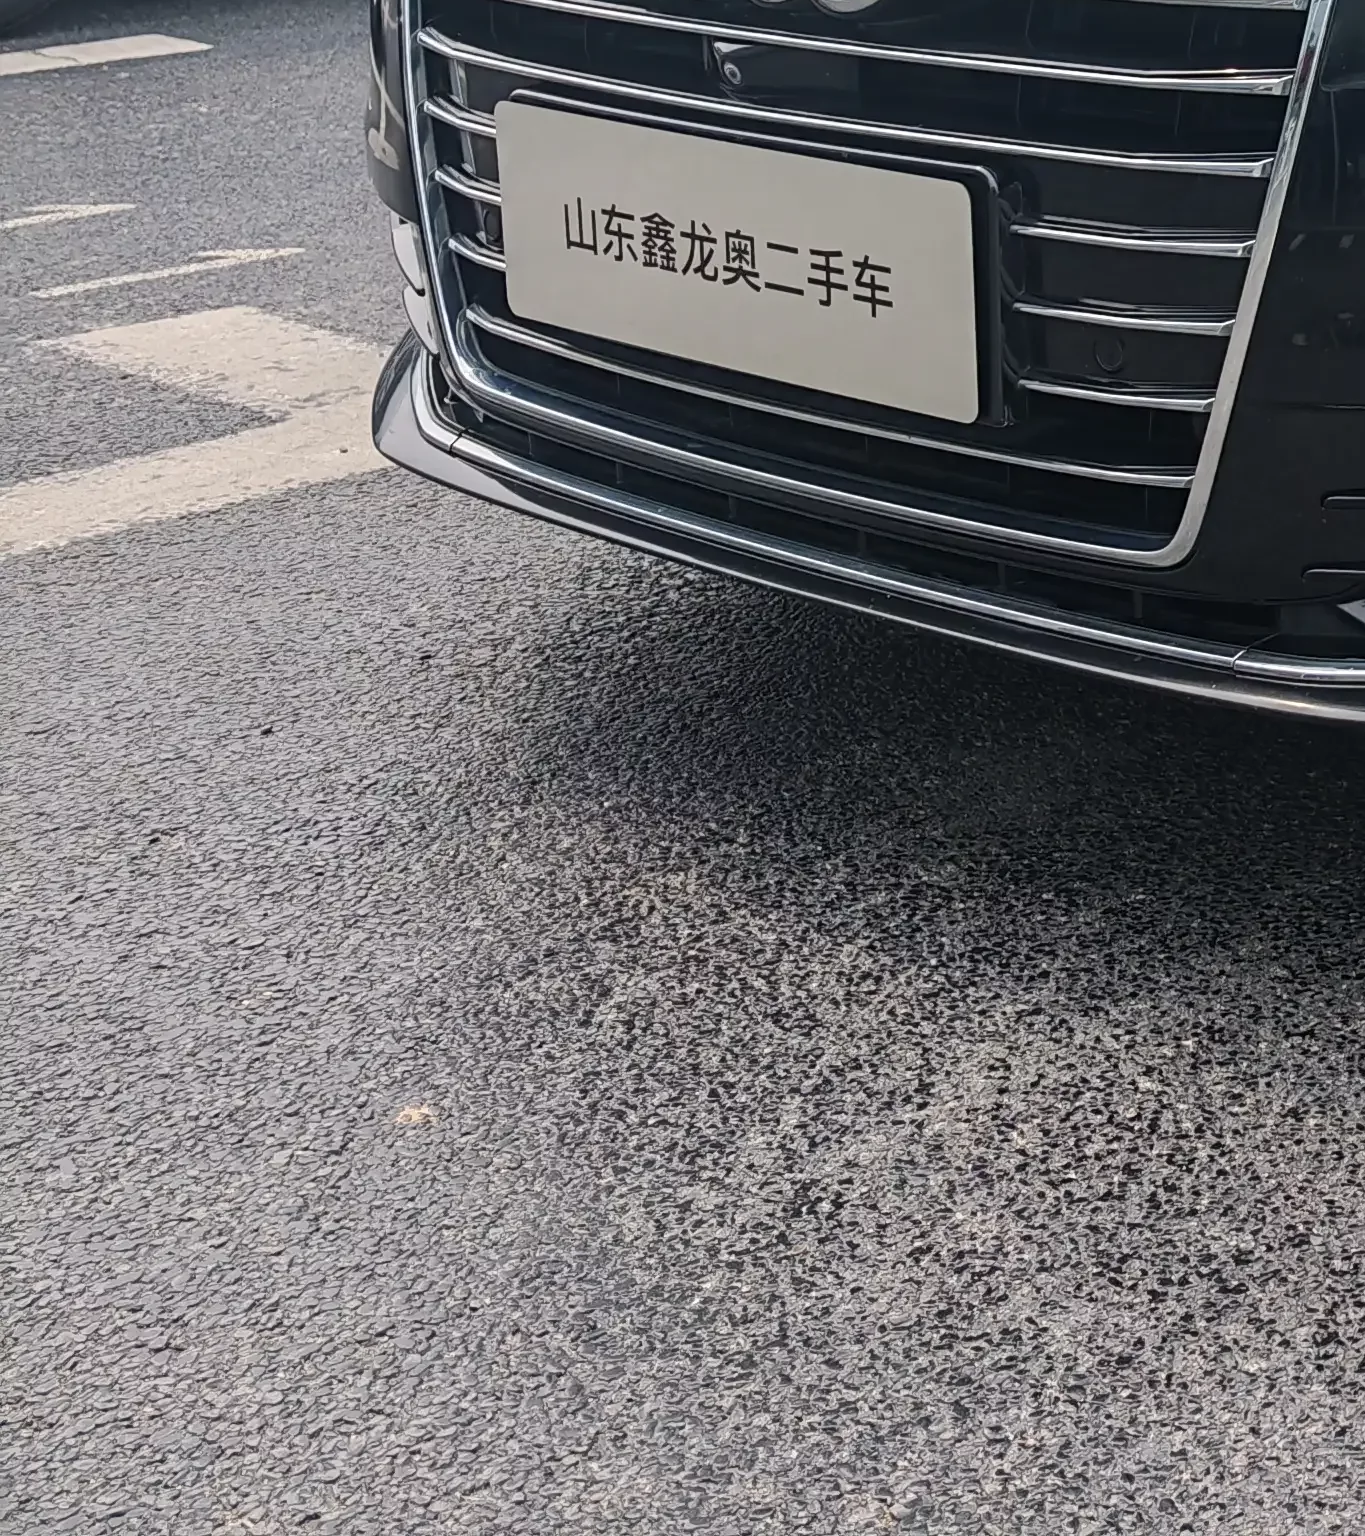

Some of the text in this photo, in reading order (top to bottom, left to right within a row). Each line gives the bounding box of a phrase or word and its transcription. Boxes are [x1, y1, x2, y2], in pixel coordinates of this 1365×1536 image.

[563, 196, 894, 319] 山东鑫龙奥二手车
